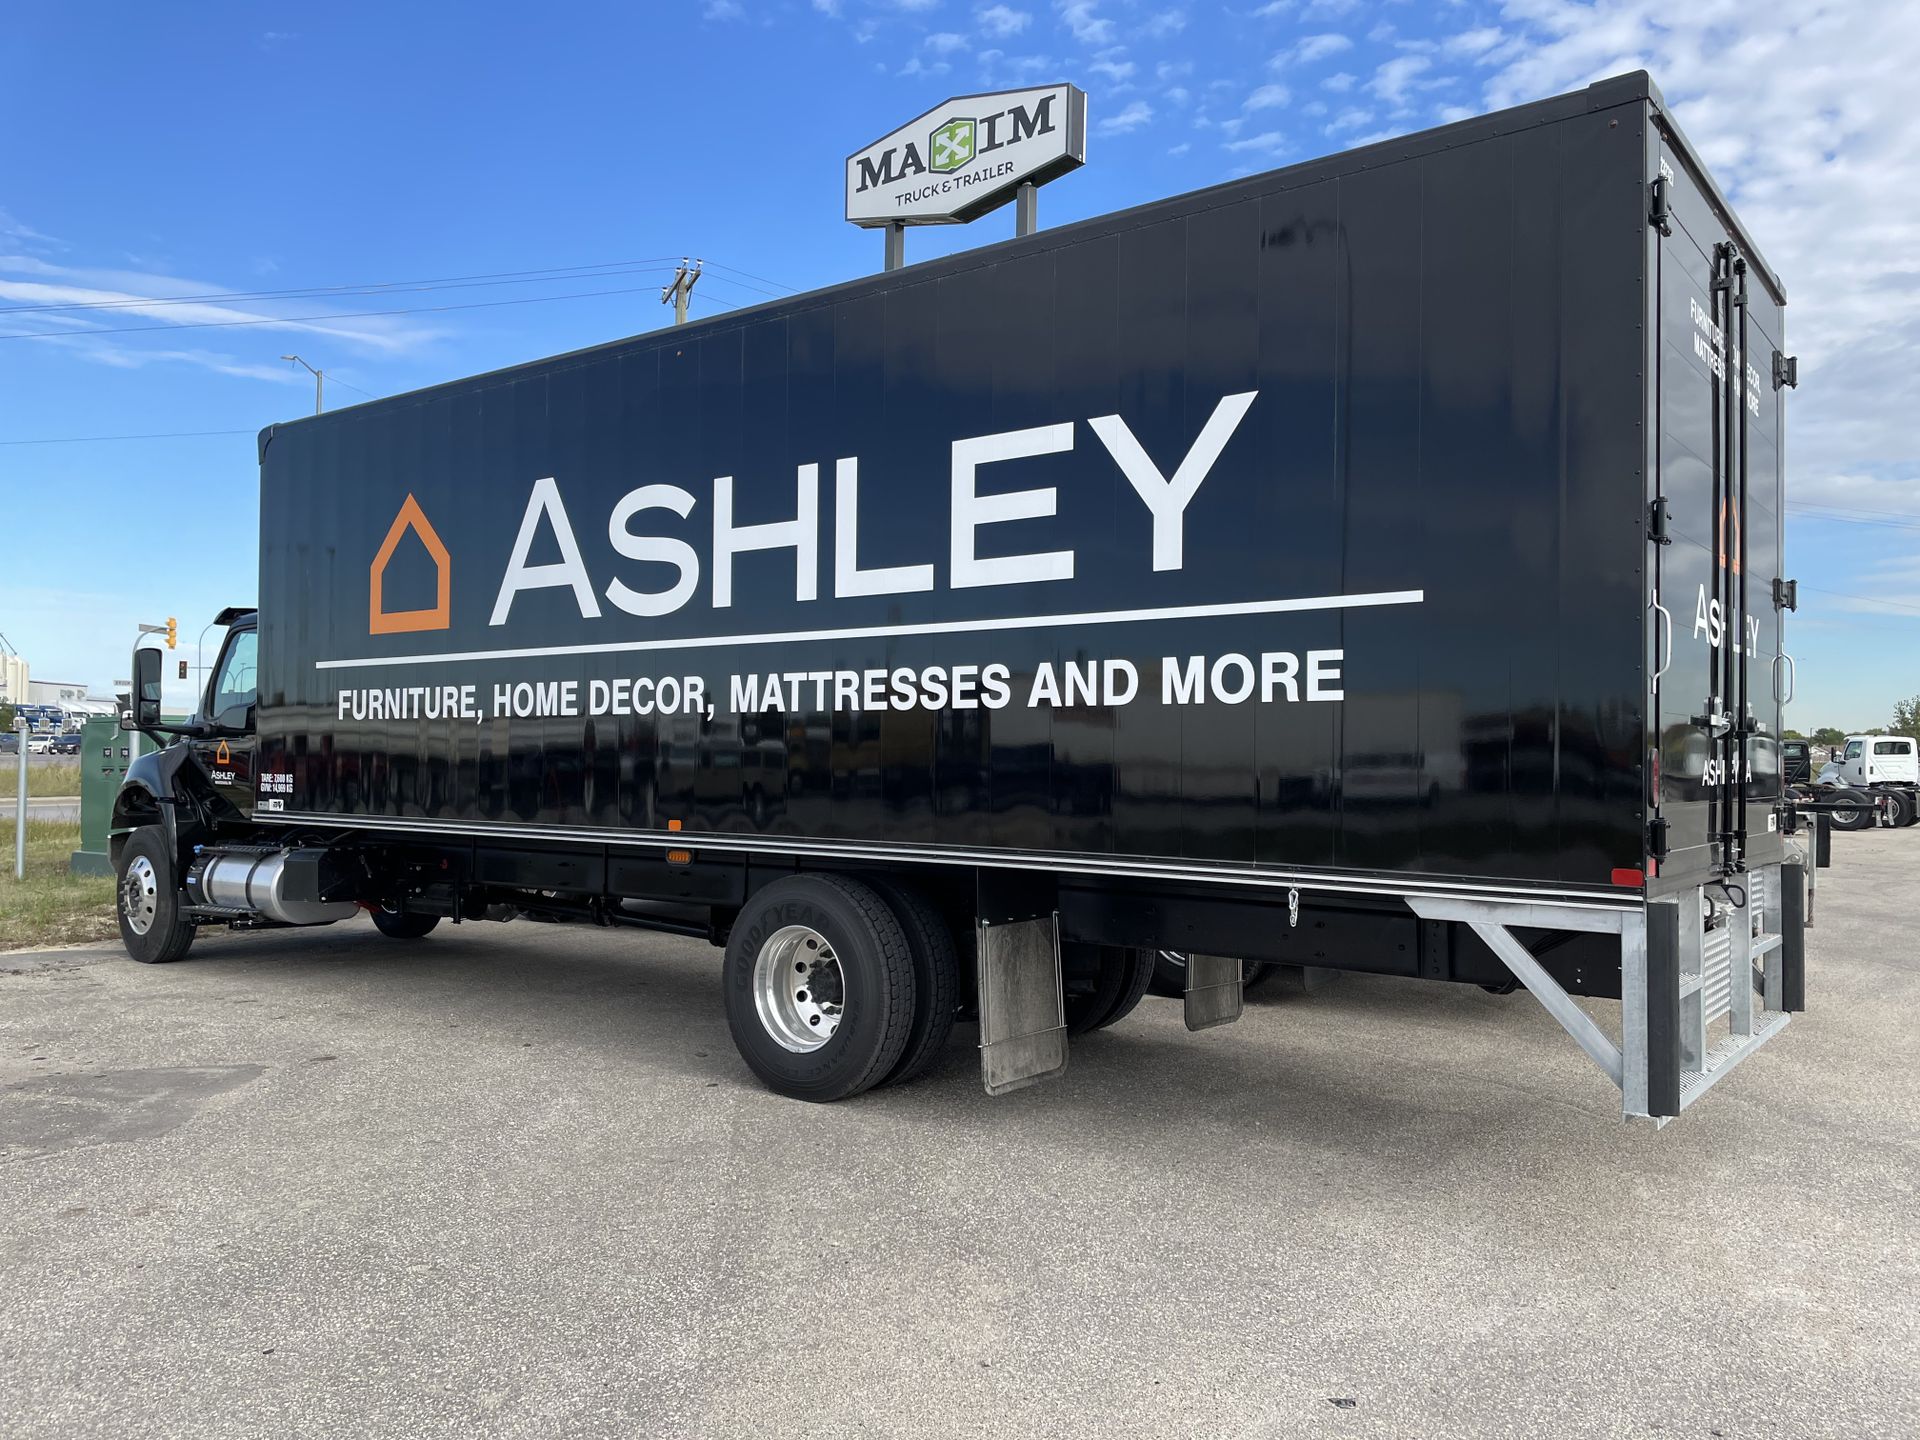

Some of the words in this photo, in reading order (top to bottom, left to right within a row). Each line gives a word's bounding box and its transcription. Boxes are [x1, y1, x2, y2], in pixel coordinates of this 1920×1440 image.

[855, 94, 1057, 193] MAXIM
[895, 184, 939, 206] TRUCK
[942, 180, 952, 192] &
[953, 161, 1014, 188] TRAILER
[1693, 331, 1726, 382] MATTRESS
[488, 390, 1260, 626] ASHLEY
[337, 685, 483, 725] FURNITURE,
[493, 681, 578, 718] HOME
[590, 676, 714, 722] DECOR,
[730, 663, 1011, 712] MATTRESSES
[1027, 659, 1139, 709] AND
[1162, 649, 1345, 706] MORE
[211, 770, 236, 780] ASHLEY
